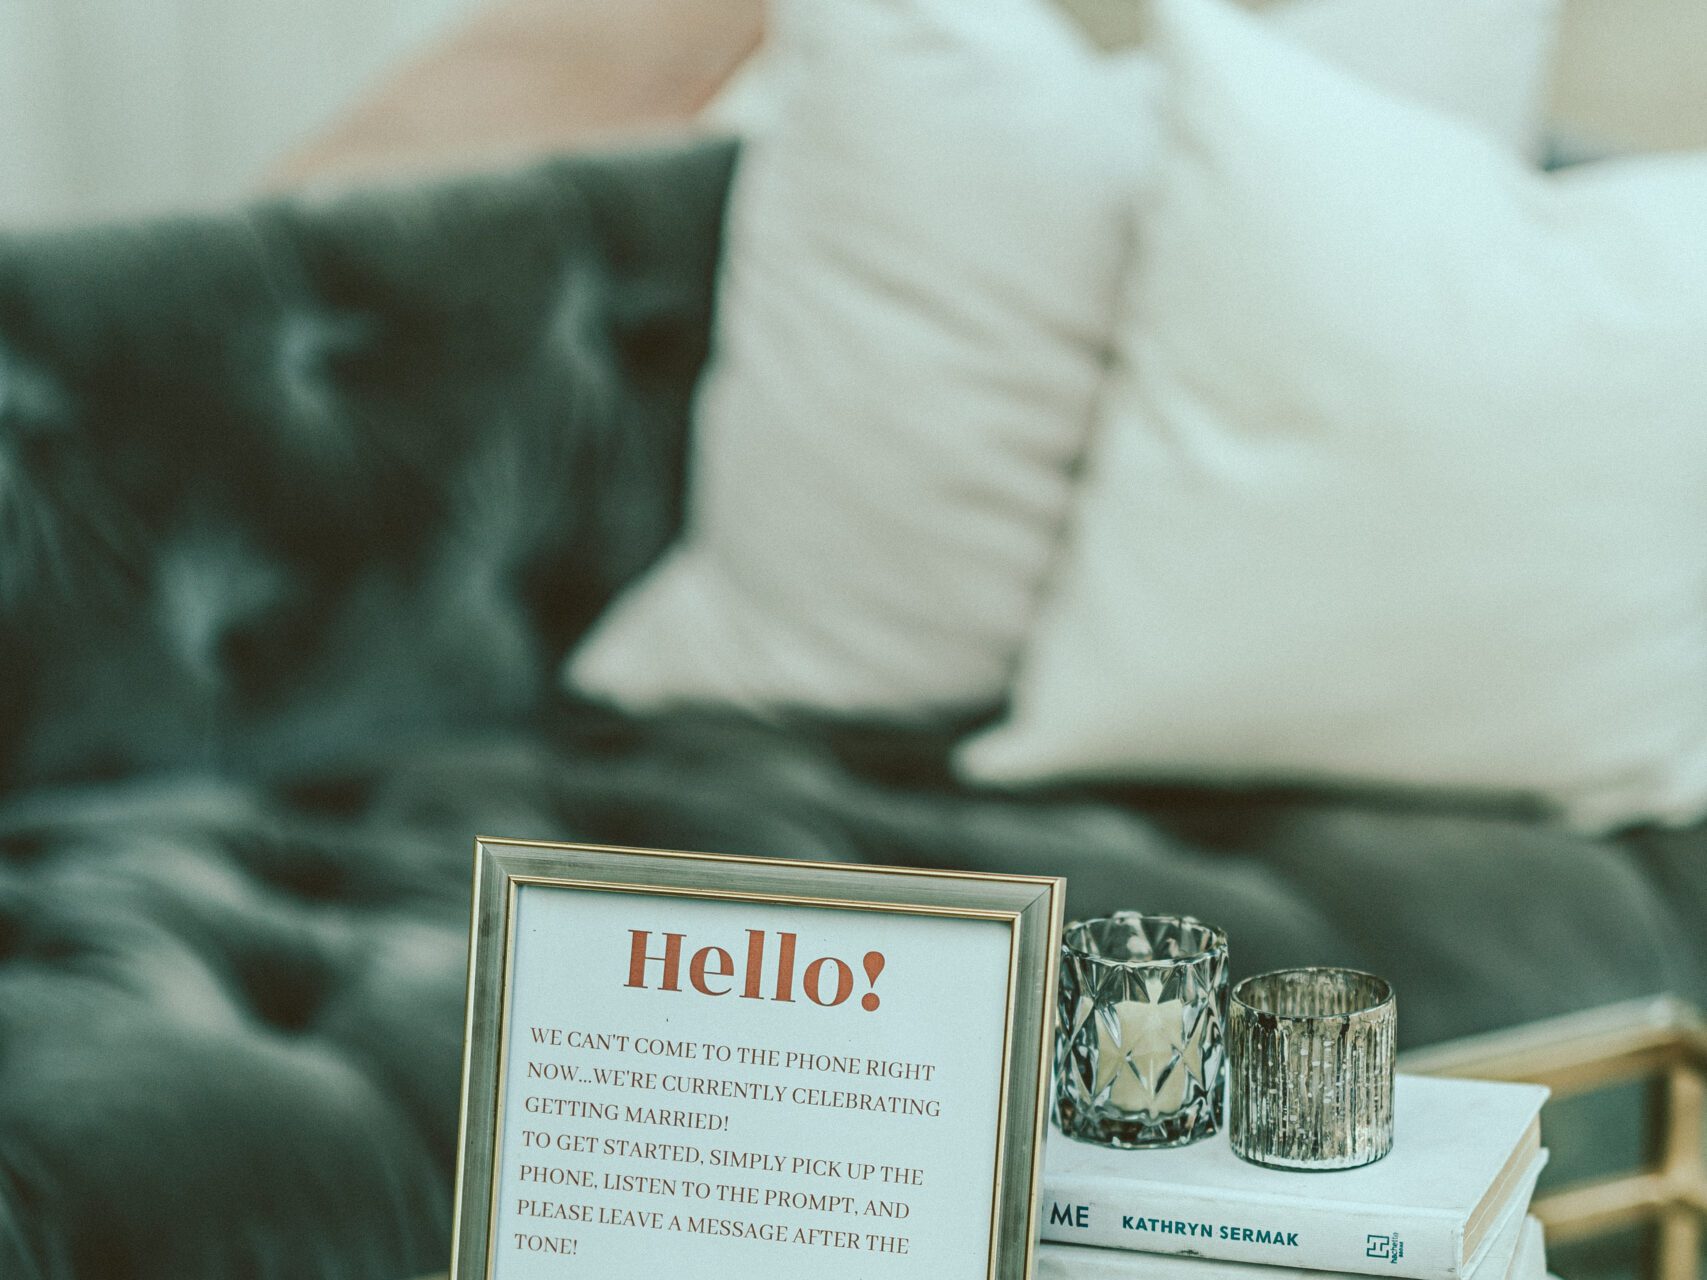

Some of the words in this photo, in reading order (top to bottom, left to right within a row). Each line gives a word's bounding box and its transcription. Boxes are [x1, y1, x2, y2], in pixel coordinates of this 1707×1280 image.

[623, 929, 885, 1012] Hello!
[531, 1028, 562, 1045] WE
[568, 1032, 629, 1051] CAN'T
[635, 1038, 697, 1058] COME
[703, 1044, 731, 1061] TO
[737, 1047, 779, 1066] THE
[785, 1052, 860, 1074] PHONE
[866, 1060, 935, 1081] RIGHT
[526, 1097, 618, 1120] GETTING
[625, 1106, 728, 1131] MARRIED!
[663, 1075, 787, 1102] CURRENTLY
[792, 1088, 939, 1116] CELEBRATING
[523, 1131, 550, 1148] TO
[557, 1135, 598, 1153] GET
[604, 1139, 703, 1165] STARTED,
[710, 1150, 787, 1171] SIMPLY
[792, 1157, 841, 1177] PICK
[847, 1162, 875, 1181] UP
[881, 1166, 923, 1185] THE
[520, 1165, 597, 1189] PHONE,
[604, 1174, 676, 1196] LISTEN
[682, 1181, 710, 1199] TO
[717, 1185, 759, 1204] THE
[764, 1190, 858, 1216] PROMPT,
[864, 1200, 909, 1218] AND
[515, 1234, 577, 1255] TONE!
[517, 1199, 593, 1222] PLEASE
[599, 1208, 663, 1229] LEAVE
[668, 1216, 681, 1231] A
[688, 1217, 787, 1242] MESSAGE
[792, 1228, 860, 1249] AFTER
[866, 1235, 908, 1254] THE
[1050, 1202, 1089, 1228] ME
[1122, 1216, 1214, 1238] KATHRYN
[1219, 1225, 1299, 1247] SERMAK
